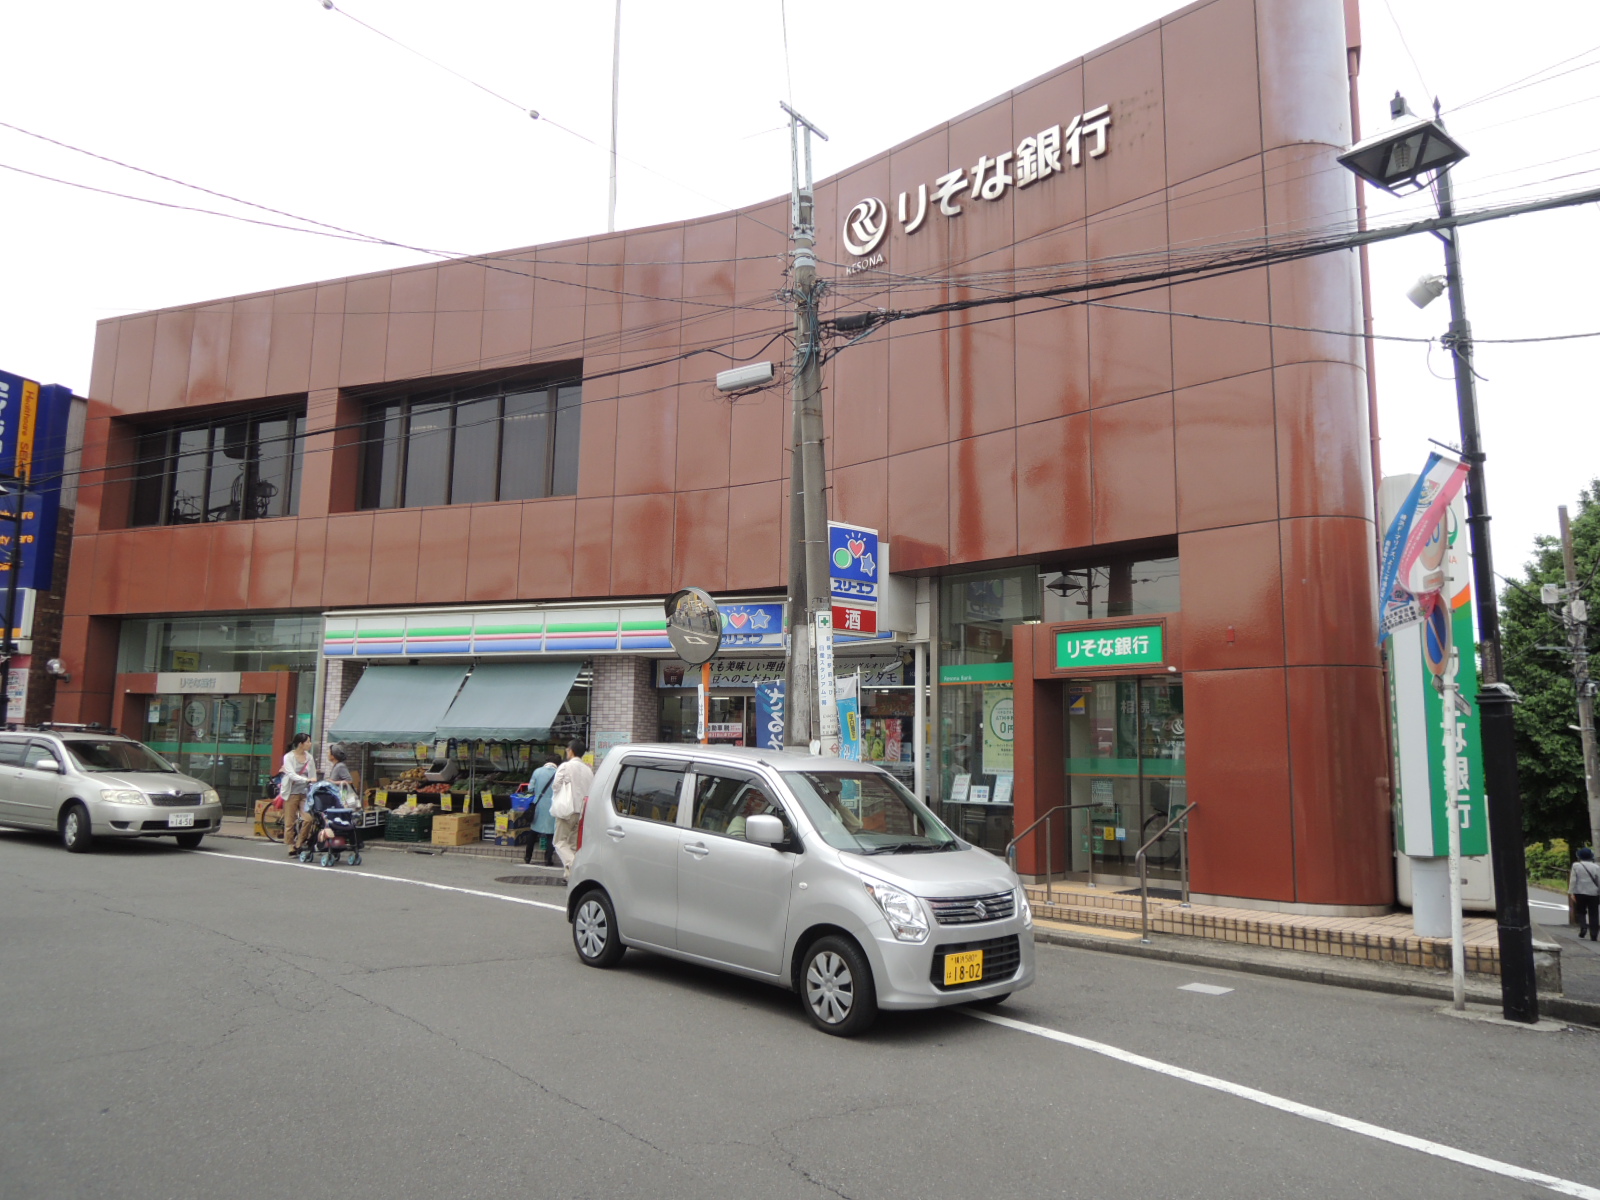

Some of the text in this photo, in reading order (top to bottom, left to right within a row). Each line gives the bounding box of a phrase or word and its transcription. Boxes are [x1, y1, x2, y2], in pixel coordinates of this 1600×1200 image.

[899, 104, 1111, 234] りそな銀行
[834, 580, 875, 594] スリーエフ
[845, 609, 862, 630] 酒
[1067, 635, 1149, 659] りそな銀行
[954, 963, 981, 981] 18-02
